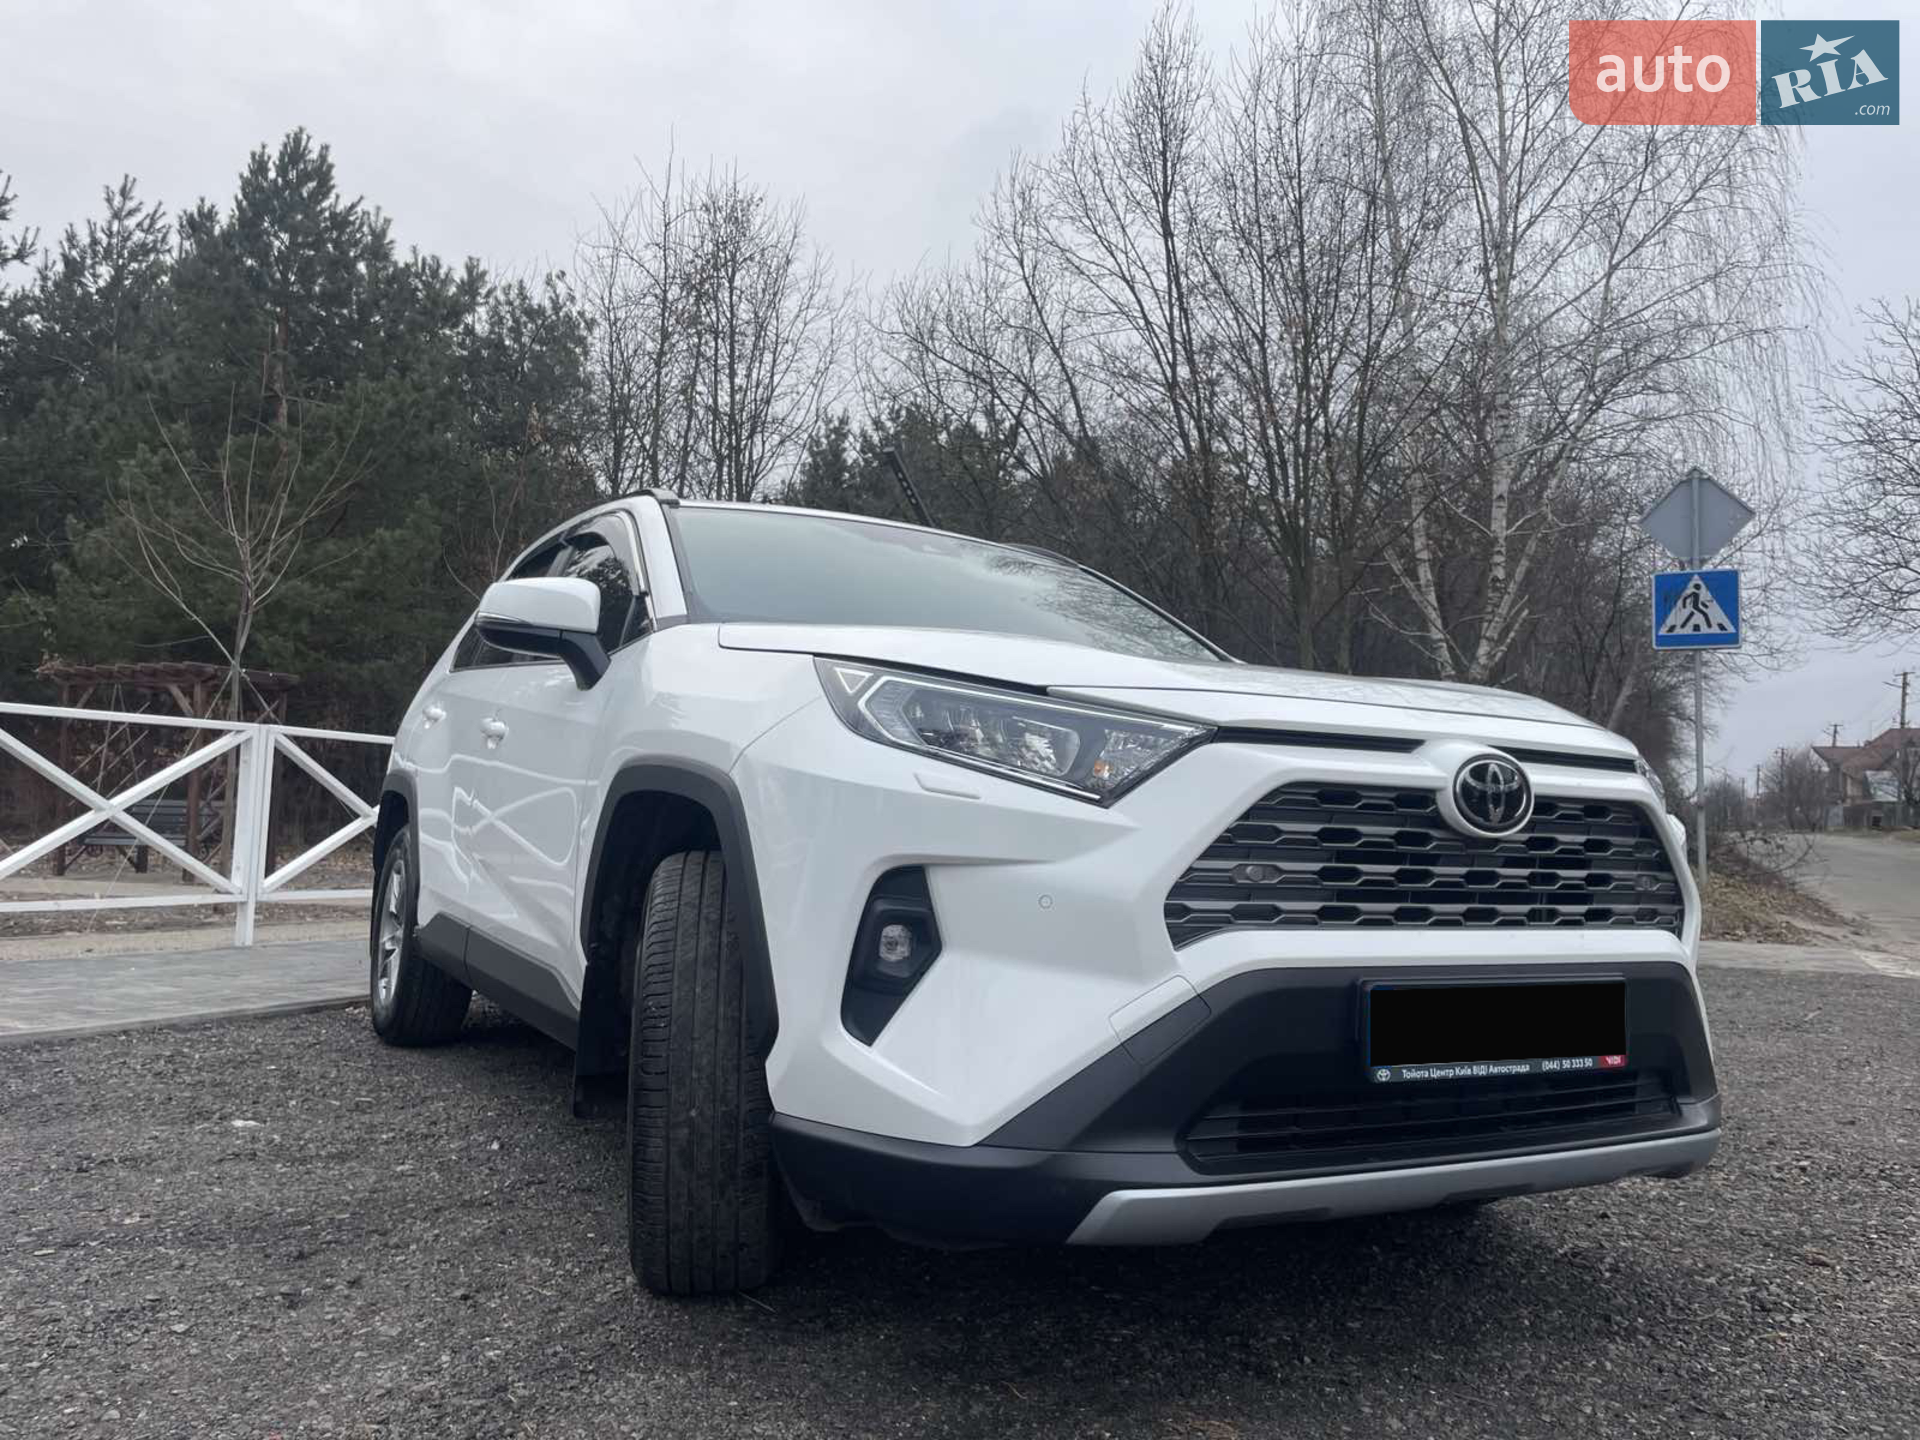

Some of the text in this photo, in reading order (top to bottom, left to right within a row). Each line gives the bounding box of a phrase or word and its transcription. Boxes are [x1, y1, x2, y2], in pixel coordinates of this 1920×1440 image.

[1402, 1069, 1429, 1079] Тойота
[1430, 1067, 1454, 1079] Центр
[1489, 1064, 1530, 1075] Автострада
[1542, 1060, 1561, 1071] (044)
